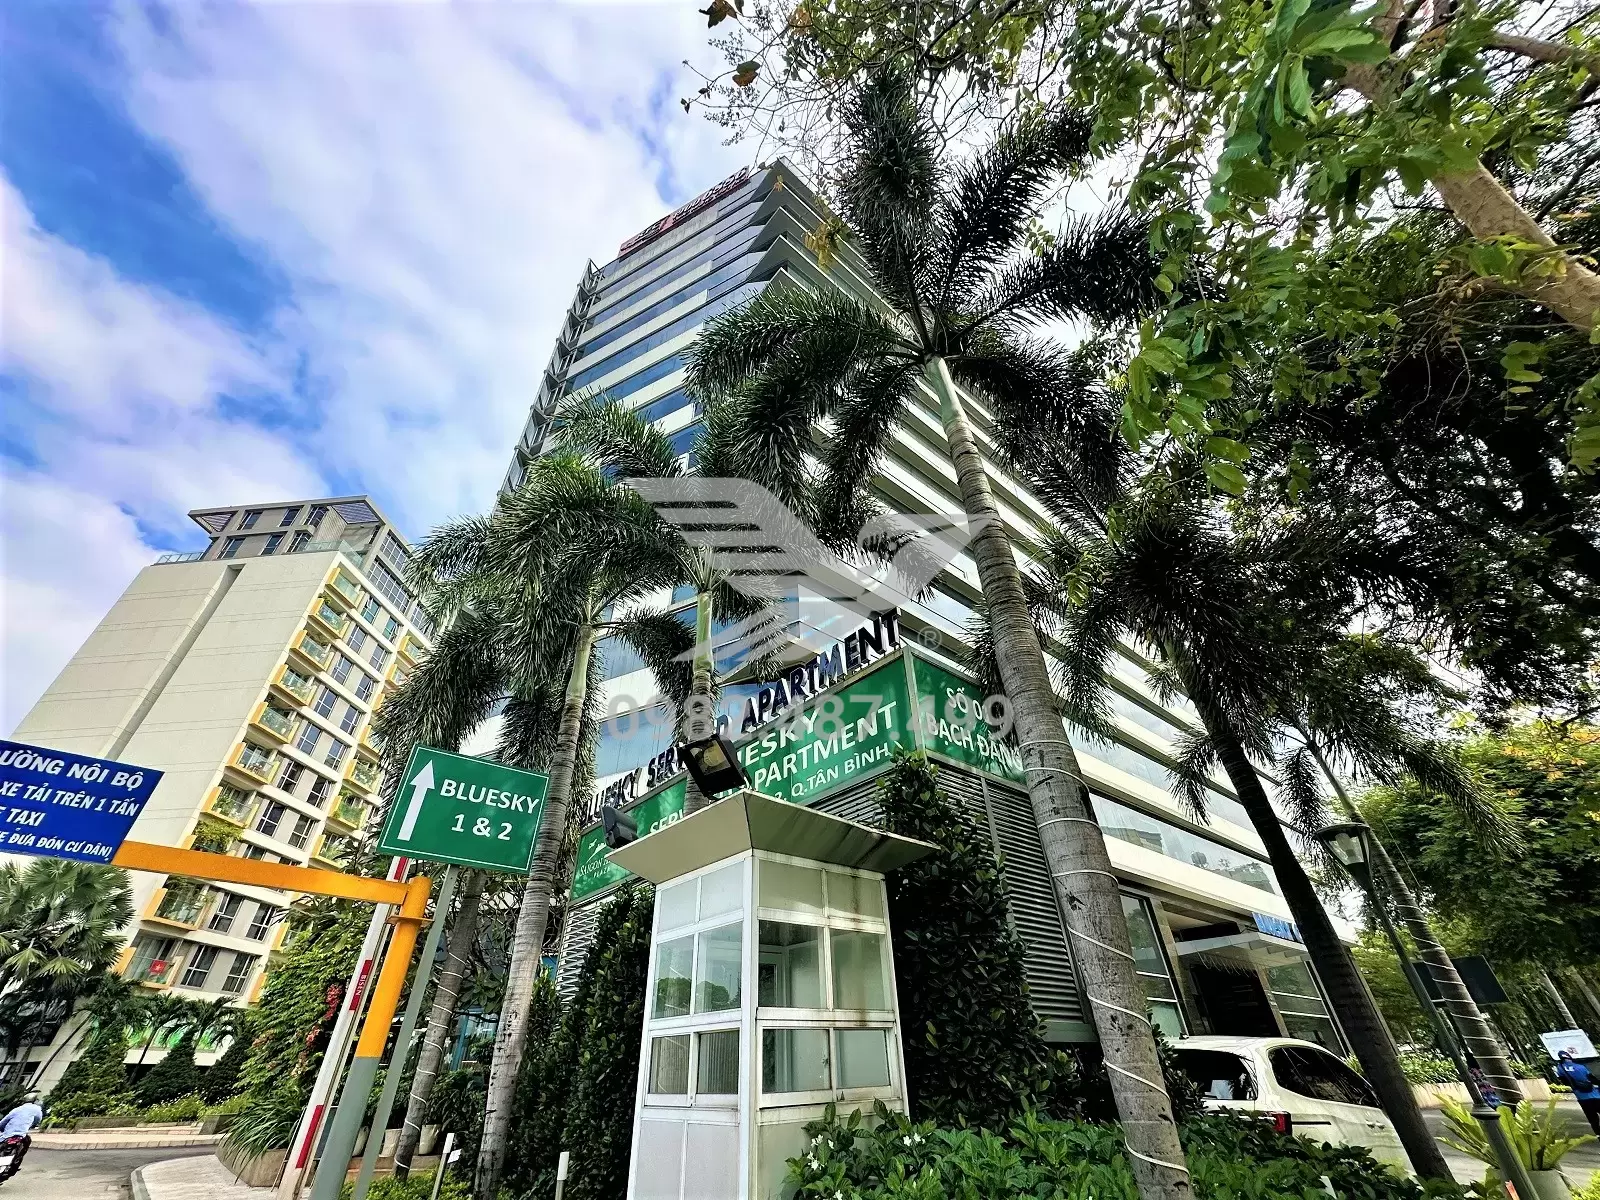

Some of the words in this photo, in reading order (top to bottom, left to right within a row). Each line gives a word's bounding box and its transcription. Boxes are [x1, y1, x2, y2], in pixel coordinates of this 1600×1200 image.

[741, 606, 902, 735] APARTMENT
[745, 701, 897, 791] PARTMENT
[926, 712, 975, 752] BẠCH
[0, 750, 65, 775] ƯỜNG
[66, 763, 109, 784] NỘI
[111, 772, 144, 791] BỘ
[791, 765, 839, 797] Q.TÂN
[0, 781, 24, 797] XE
[23, 783, 53, 802] TẢI
[53, 790, 96, 809] TRÊN
[95, 798, 107, 811] 1
[109, 797, 139, 817] TẤN
[440, 778, 540, 815] BLUESKY
[6, 808, 46, 827] TAXI
[451, 813, 465, 833] 1
[472, 817, 491, 838] &
[498, 822, 513, 841] 2
